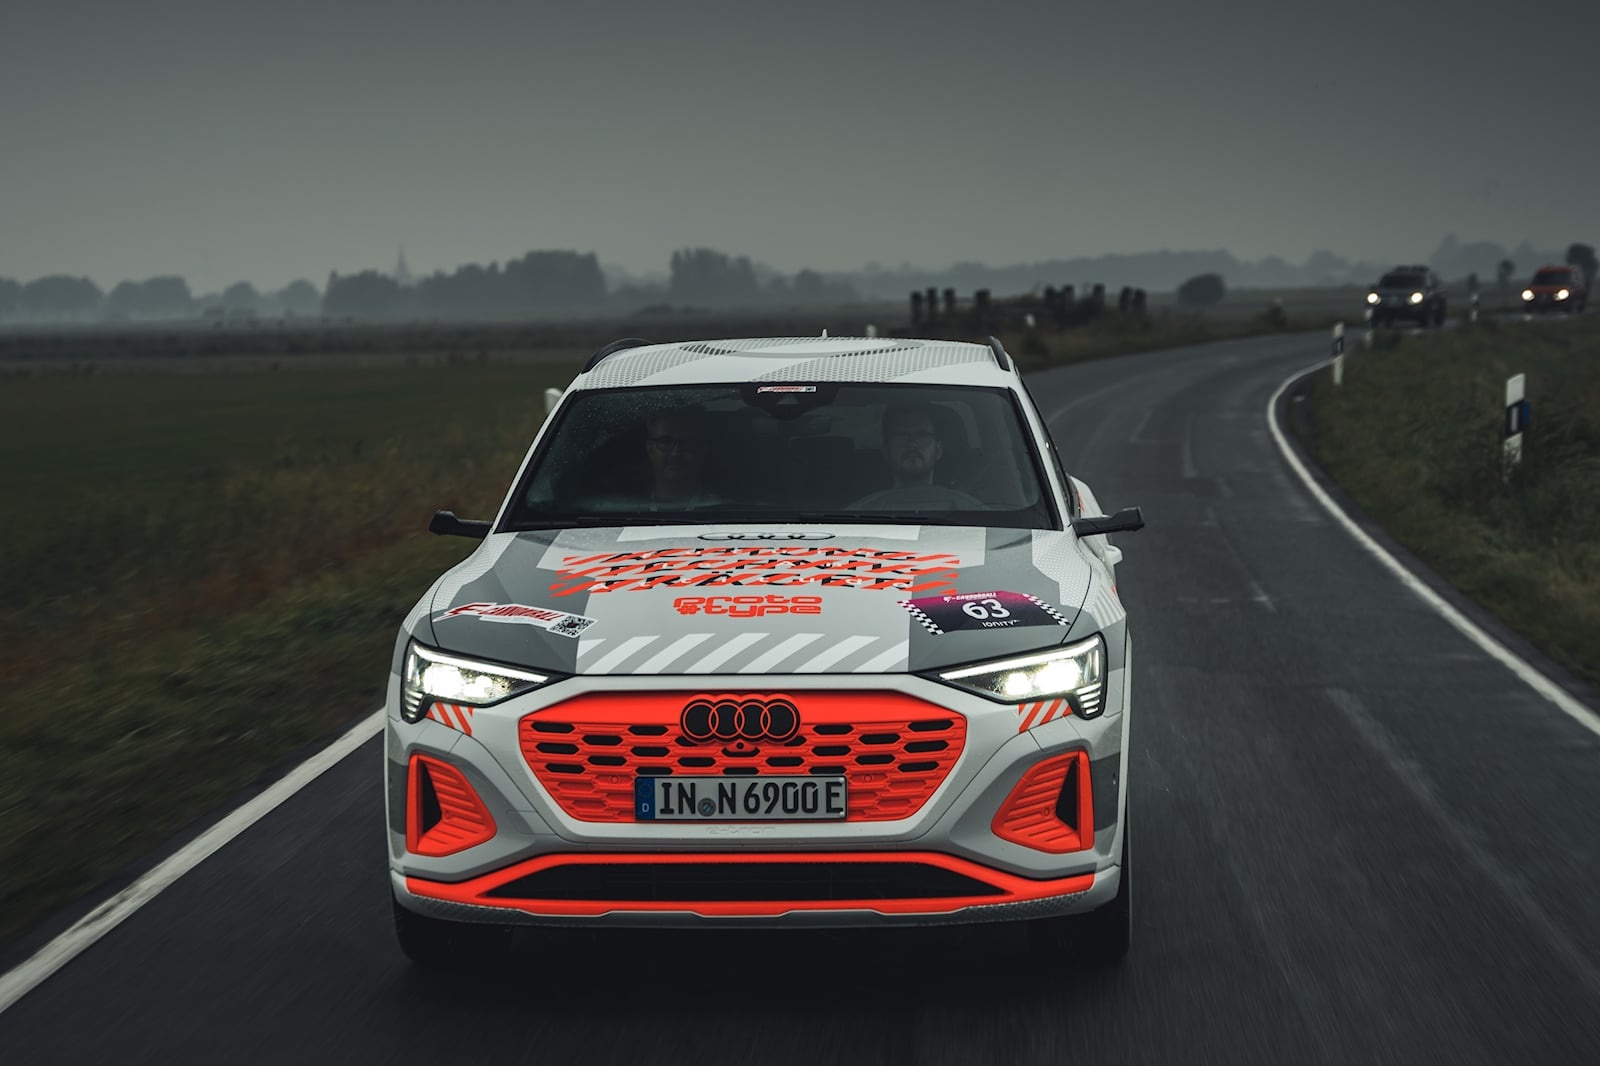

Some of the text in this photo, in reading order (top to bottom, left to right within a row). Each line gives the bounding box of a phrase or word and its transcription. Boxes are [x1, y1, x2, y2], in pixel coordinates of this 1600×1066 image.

[673, 595, 823, 608] proto
[676, 605, 822, 618] #type
[962, 598, 1010, 620] 63
[659, 782, 696, 815] IN
[718, 782, 736, 814] N
[641, 803, 650, 813] D
